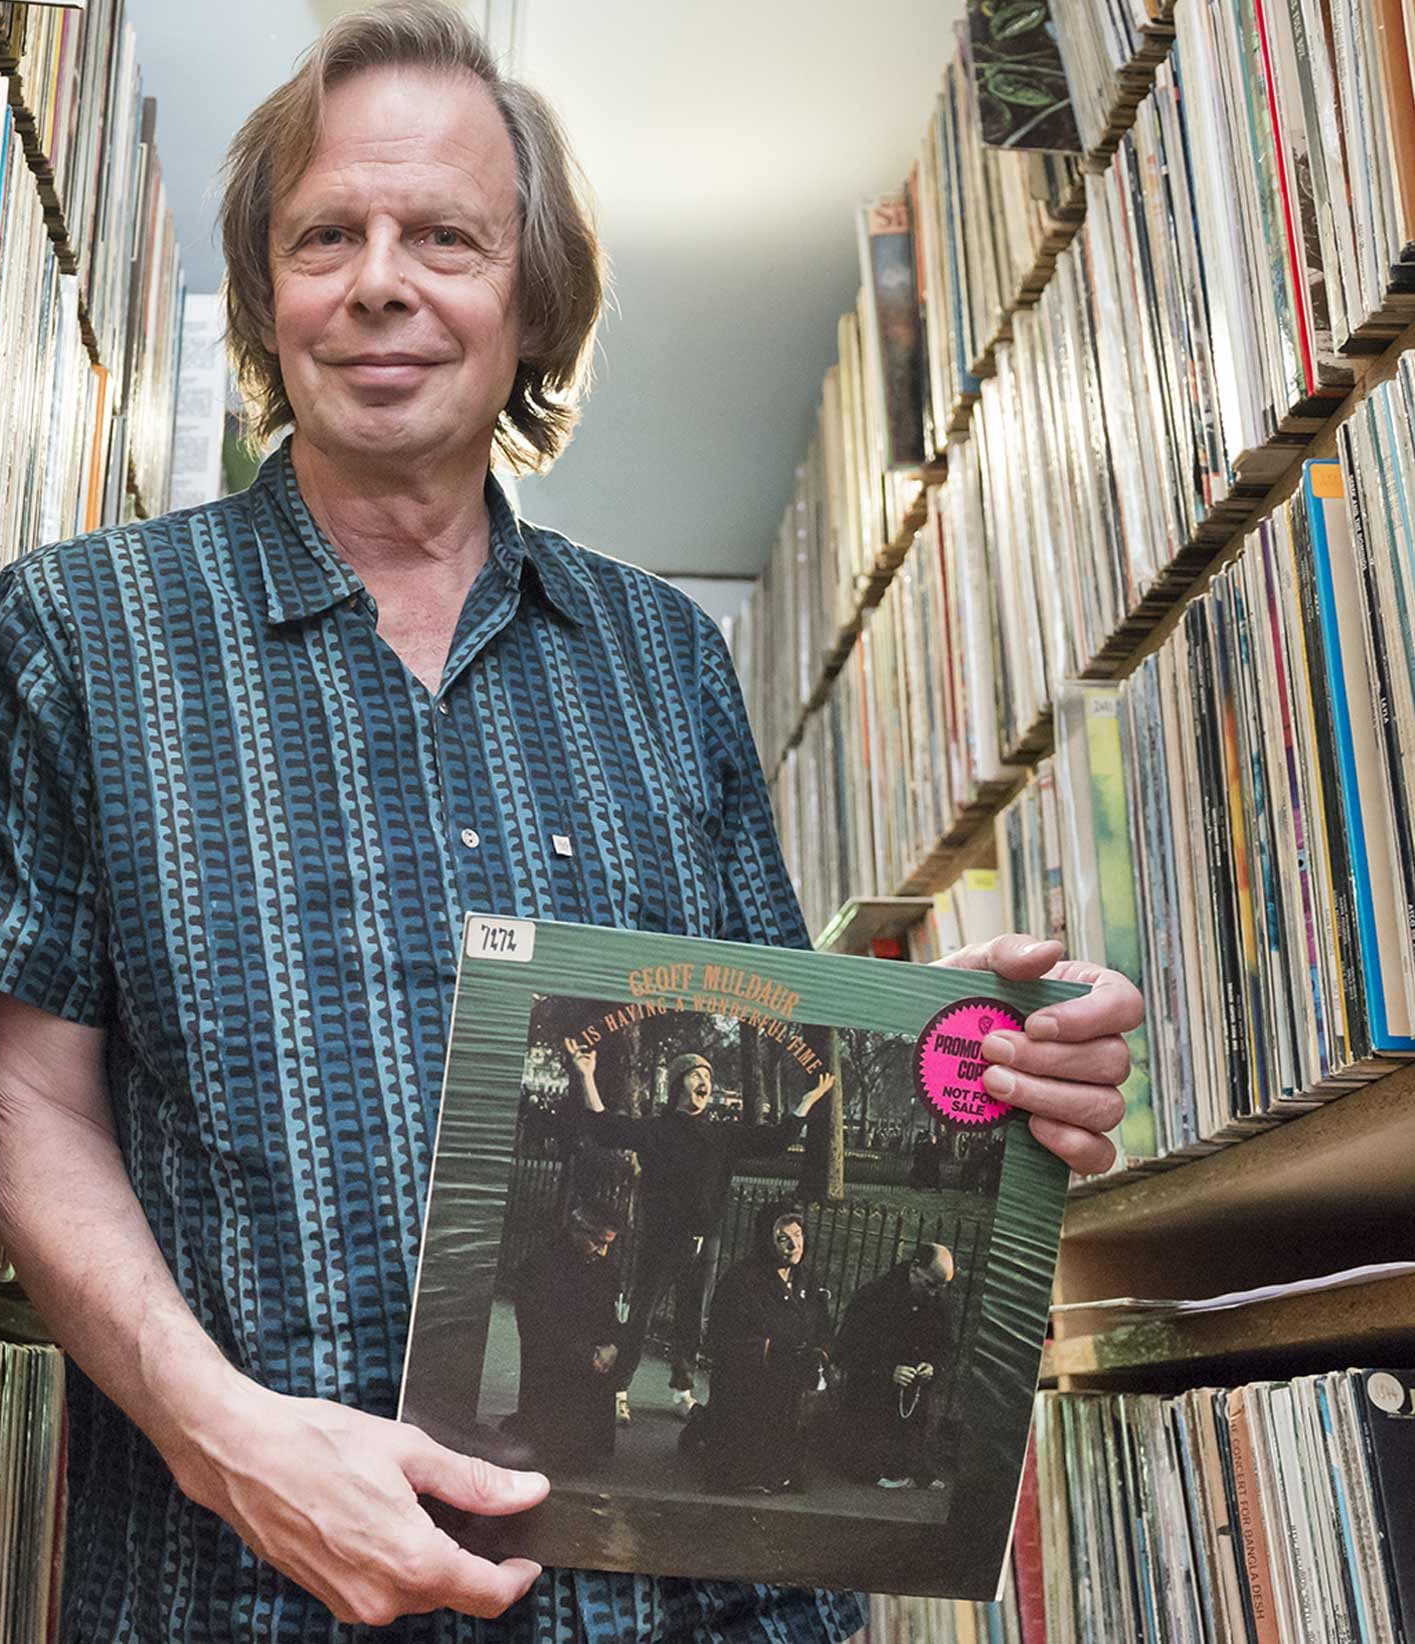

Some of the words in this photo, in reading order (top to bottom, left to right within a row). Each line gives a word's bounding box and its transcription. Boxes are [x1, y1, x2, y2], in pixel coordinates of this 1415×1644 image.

[629, 963, 695, 997] GEOFF
[702, 963, 801, 1020] MULDAUR
[582, 1025, 602, 1046] IS
[604, 997, 667, 1033] HAVING
[675, 996, 685, 1013] A
[693, 993, 788, 1043] WONDERFUL
[787, 1035, 823, 1075] TIME
[934, 1033, 984, 1061] PROMO
[957, 1060, 988, 1082] COP
[943, 1086, 970, 1100] NOT
[951, 1101, 985, 1116] SALE
[1232, 1438, 1248, 1496] CONCERT
[1240, 1500, 1251, 1525] FOR
[1244, 1529, 1260, 1581] BANGLA
[1251, 1584, 1265, 1619] DESH
